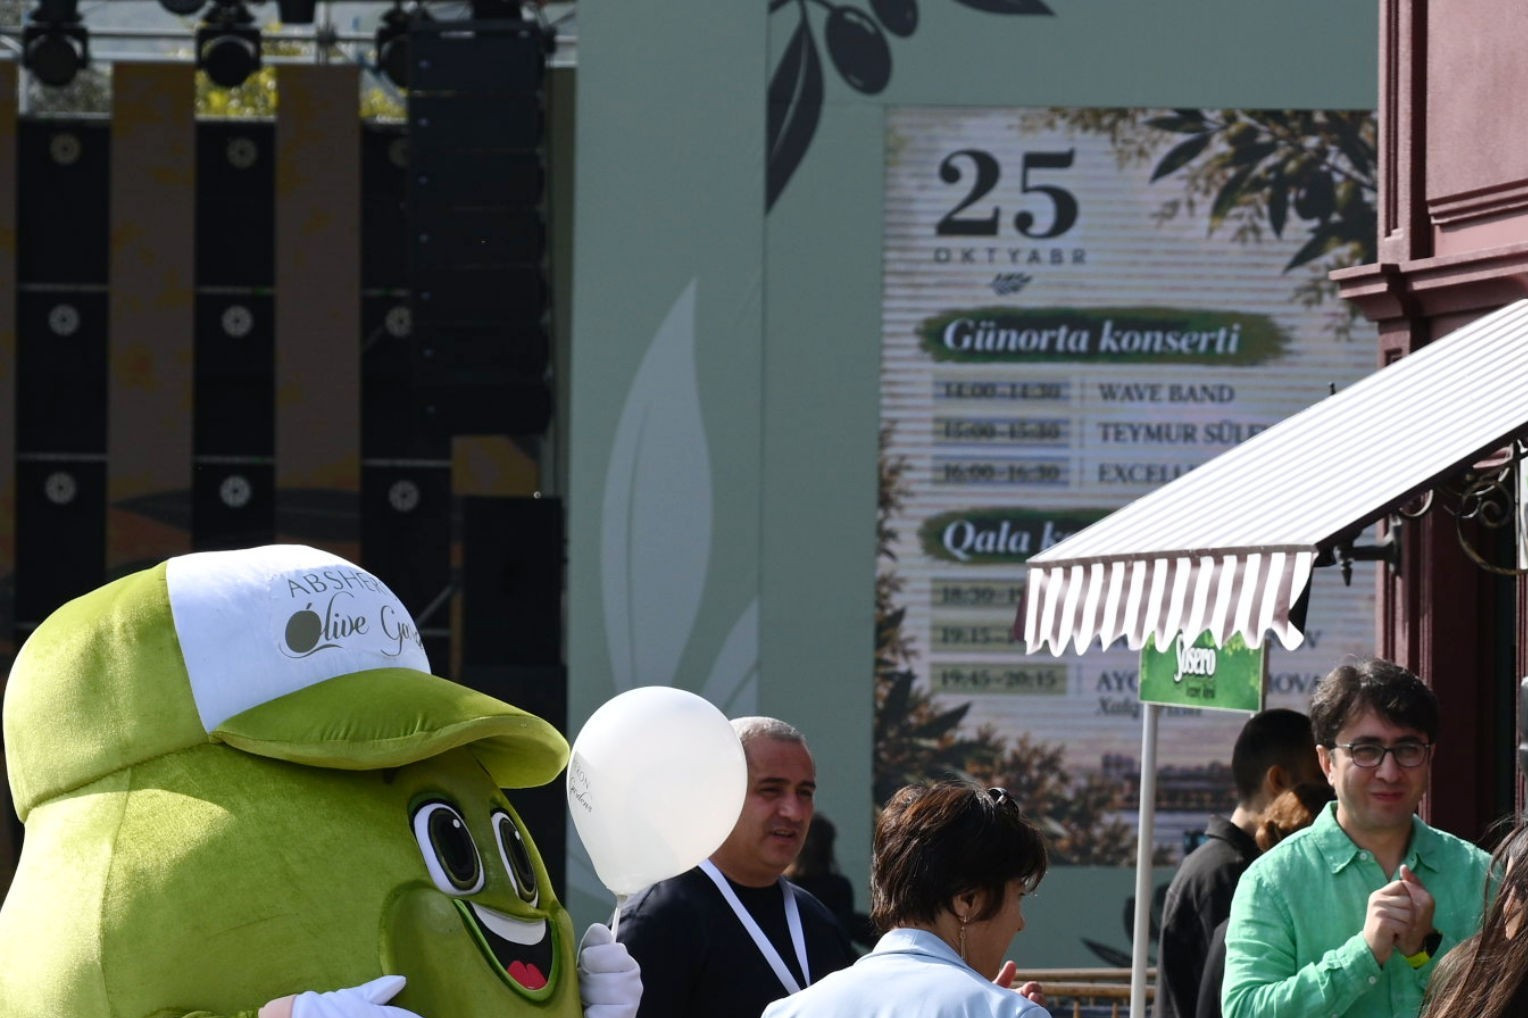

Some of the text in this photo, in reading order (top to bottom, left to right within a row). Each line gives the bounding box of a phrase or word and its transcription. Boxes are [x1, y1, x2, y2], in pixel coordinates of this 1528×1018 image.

[935, 147, 1080, 239] 25
[934, 247, 1087, 265] OKTYABR
[944, 317, 1243, 355] Günorta konserti
[1099, 384, 1236, 403] WAVE BAND
[1100, 422, 1198, 444] TEYMUR
[943, 520, 1033, 560] Qala
